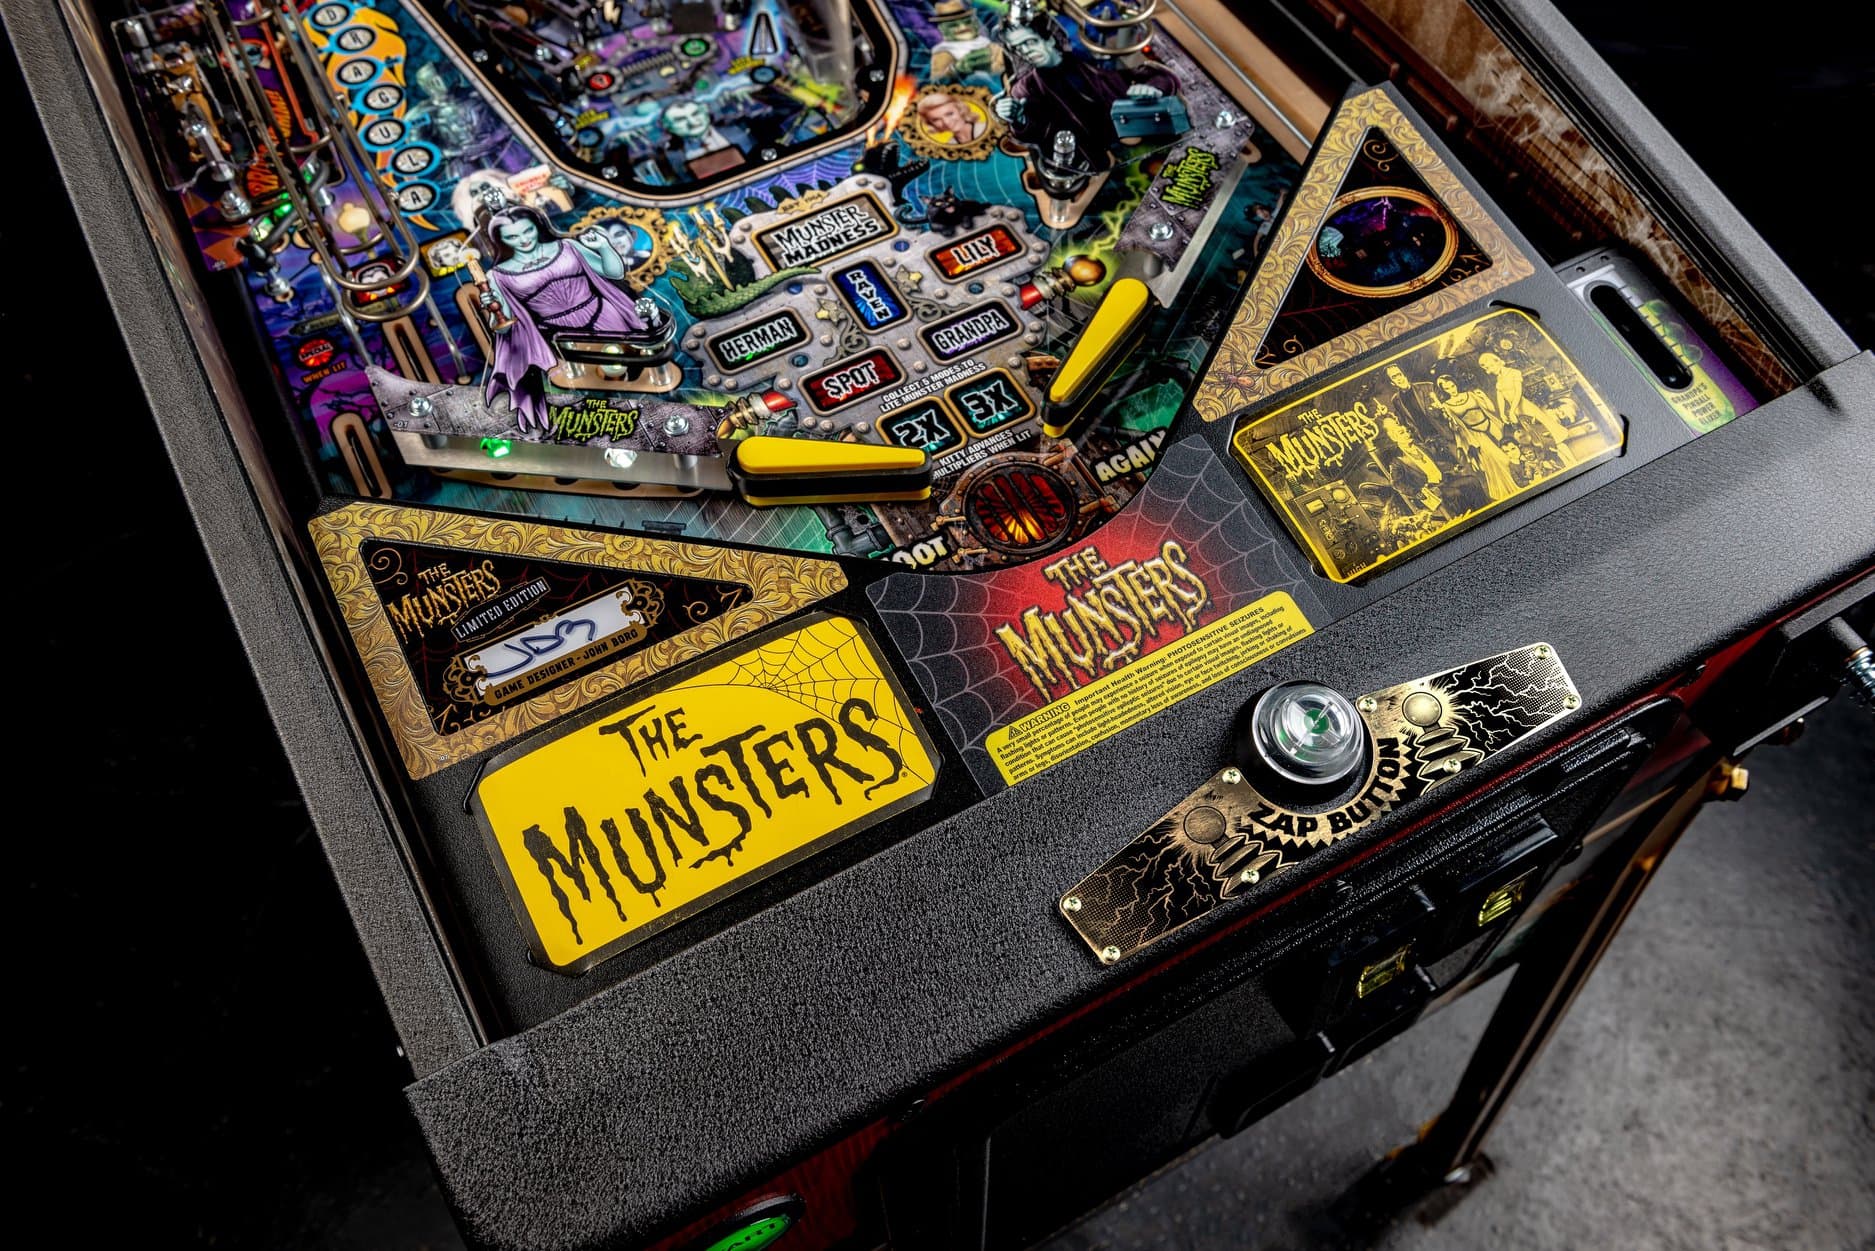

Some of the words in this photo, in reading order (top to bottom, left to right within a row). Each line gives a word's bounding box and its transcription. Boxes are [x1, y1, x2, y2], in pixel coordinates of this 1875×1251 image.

[1161, 147, 1219, 209] MUNSTERS
[774, 205, 867, 250] MUNSTER
[784, 220, 879, 265] MADNESS
[952, 235, 999, 265] LILY
[848, 271, 891, 321] RAVEN
[719, 317, 797, 362] HERMAN
[933, 310, 1010, 354] GRANDPA
[303, 368, 330, 383] WHEN
[332, 361, 346, 373] LIT
[824, 360, 879, 399] SPOT
[880, 399, 902, 412] LITE
[900, 383, 944, 405] MUNSTER
[944, 363, 986, 384] MADNESS
[883, 381, 921, 403] COLLECT
[921, 378, 929, 386] 5
[930, 366, 961, 381] MODES
[962, 359, 974, 368] TO
[1671, 382, 1708, 404] GRANDPA'S
[550, 406, 639, 441] MUNSTERS
[586, 399, 607, 412] THE
[961, 380, 1019, 423] 3X
[1297, 408, 1322, 424] THE
[1682, 394, 1711, 410] PINBALL
[892, 408, 950, 449] 2X
[939, 450, 968, 467] KITTY
[968, 430, 1013, 453] ADVANCES
[1265, 402, 1379, 480] MUNSTERS
[933, 450, 988, 480] MULTIPLIERS
[990, 440, 1016, 455] WHEN
[1016, 430, 1032, 443] LIT
[417, 562, 451, 585] THE
[1043, 545, 1108, 590] THE
[387, 559, 501, 645] MUNSTERS
[454, 605, 504, 639] LIMITED
[504, 579, 549, 611] EDITION
[993, 540, 1208, 703] MUNSTERS
[494, 679, 524, 700] GAME
[527, 659, 576, 685] DESIGNER
[582, 641, 608, 660] JOHN
[612, 627, 639, 646] BORG
[1002, 741, 1015, 751] very
[1015, 732, 1031, 743] small
[1031, 715, 1064, 735] percentage
[1070, 702, 1090, 716] people
[1090, 697, 1103, 706] may
[1102, 681, 1133, 700] experience
[1137, 668, 1158, 681] seizure
[1158, 660, 1173, 670] when
[1173, 649, 1197, 664] exposed
[1202, 635, 1223, 648] certain
[1222, 627, 1239, 638] visual
[1259, 604, 1284, 620] including
[1019, 701, 1071, 734] WARNING
[1074, 684, 1111, 706] Important
[1110, 672, 1135, 687] Health
[1135, 656, 1167, 675] Warning:
[1167, 624, 1228, 658] PHOTOSENSITIVE
[1228, 606, 1264, 627] SEIZURES
[1000, 745, 1024, 760] flashing
[1023, 736, 1040, 748] lights
[1073, 712, 1087, 722] Even
[1087, 703, 1106, 716] people
[1106, 696, 1119, 705] with
[1127, 682, 1148, 695] history
[1154, 667, 1177, 681] seizures
[1183, 652, 1207, 667] epilepsy
[1207, 647, 1219, 656] may
[1218, 639, 1232, 649] have
[1239, 619, 1273, 639] undiagnosed
[1004, 749, 1031, 766] condition
[1031, 743, 1043, 752] that
[1044, 738, 1055, 746] can
[1056, 729, 1073, 740] cause
[1115, 694, 1140, 710] epileptic
[1165, 676, 1176, 684] due
[1183, 662, 1203, 675] certain
[1203, 654, 1220, 665] visual
[1240, 633, 1262, 647] flashing
[1261, 625, 1278, 636] lights
[1013, 770, 1027, 779] arms
[1118, 706, 1151, 726] momentary
[1150, 700, 1162, 708] loss
[1200, 675, 1211, 683] and
[1211, 669, 1223, 678] loss
[1229, 646, 1269, 668] consciousness
[1274, 627, 1306, 645] convulsions
[1034, 741, 1065, 760] Symptoms
[1065, 736, 1076, 744] can
[1076, 724, 1096, 738] include
[1144, 690, 1165, 703] altered
[1184, 677, 1194, 685] eye
[1200, 666, 1213, 675] face
[1239, 643, 1259, 656] jerking
[1265, 629, 1287, 643] shaking
[598, 703, 703, 778] THE
[1247, 800, 1318, 838] ZAP
[1330, 734, 1403, 836] BUTTON
[522, 698, 904, 945] MUNSTERS
